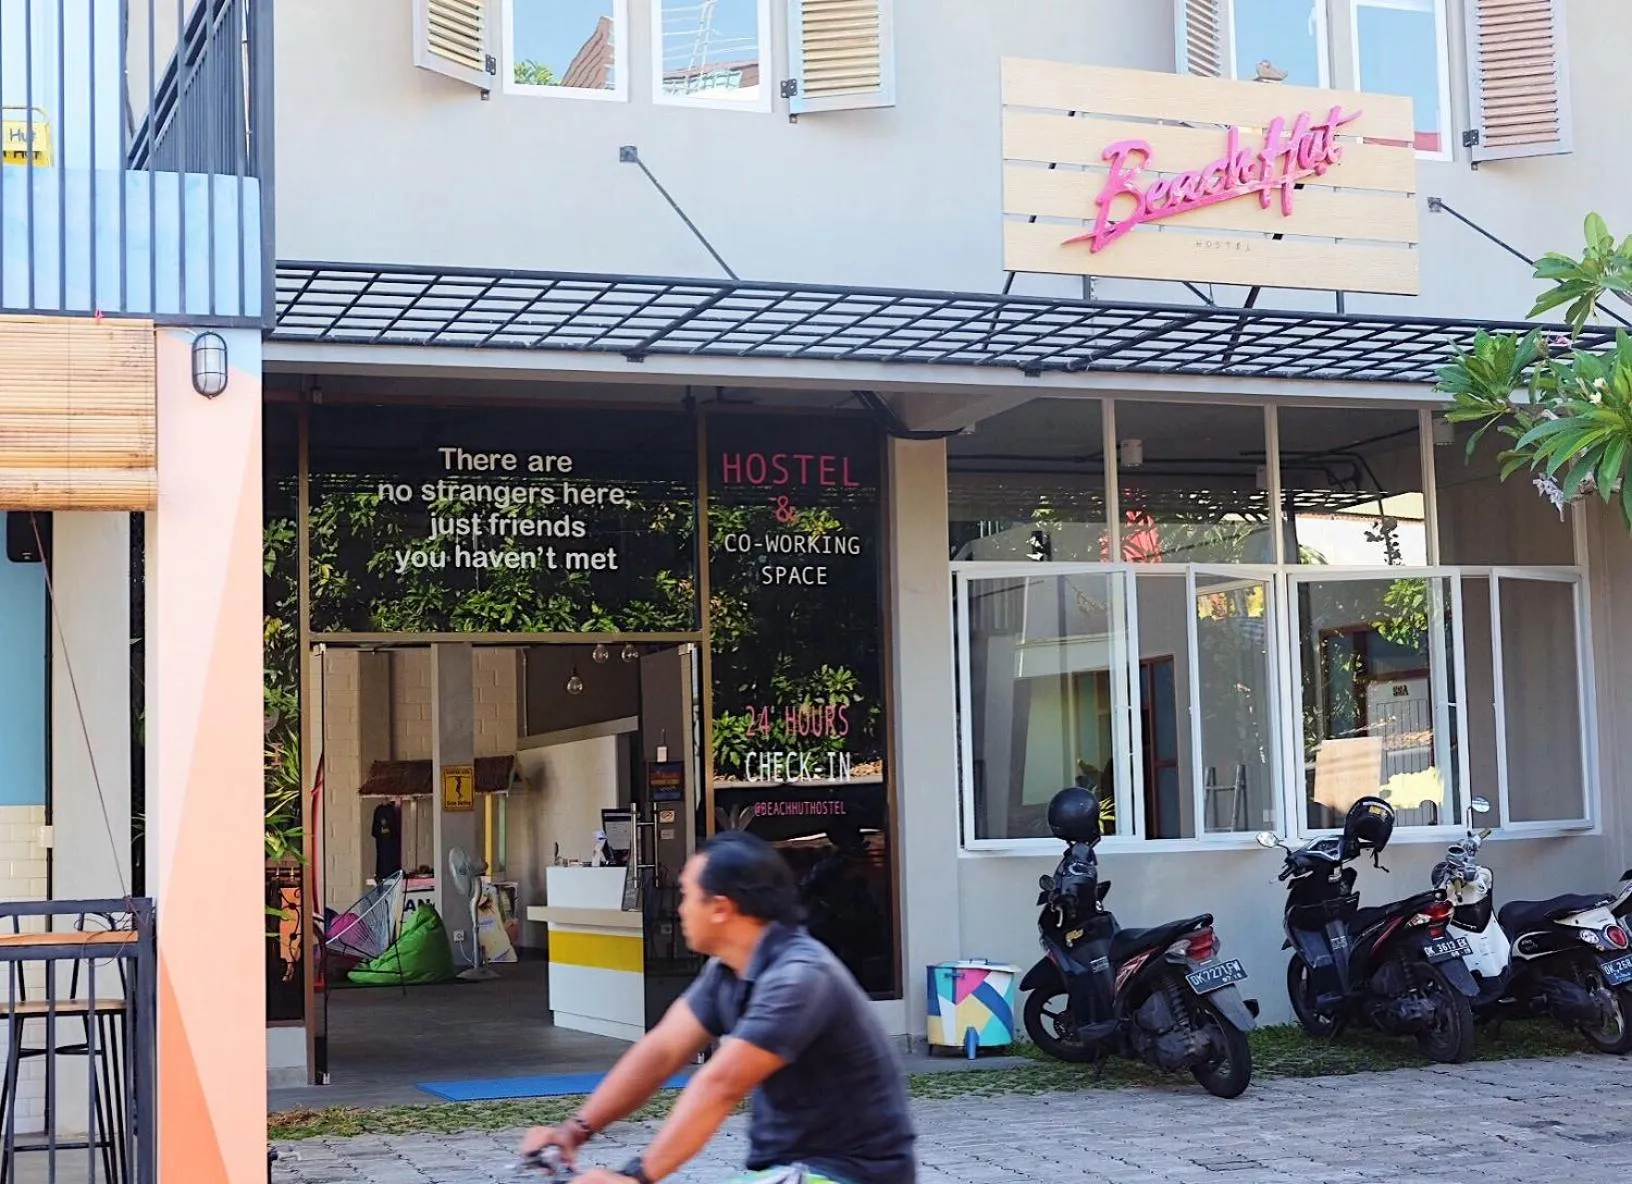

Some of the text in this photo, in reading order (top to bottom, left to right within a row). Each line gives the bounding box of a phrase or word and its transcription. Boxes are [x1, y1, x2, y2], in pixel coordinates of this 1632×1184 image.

[1061, 104, 1364, 255] Beach Hut
[1194, 239, 1251, 251] HOSTEL
[438, 447, 573, 472] There are
[722, 452, 861, 487] HOSTEL
[377, 479, 632, 510] no strangers here,
[775, 495, 796, 523] &
[428, 512, 586, 541] just friends
[724, 533, 861, 555] CO-WORKING
[395, 549, 446, 574] you
[565, 547, 618, 570] met
[761, 566, 828, 586] SPACE
[745, 704, 850, 738] 24 HOURS
[745, 751, 851, 783] CHECK-IN
[754, 801, 847, 817] @BEACHHUTHOSTEL
